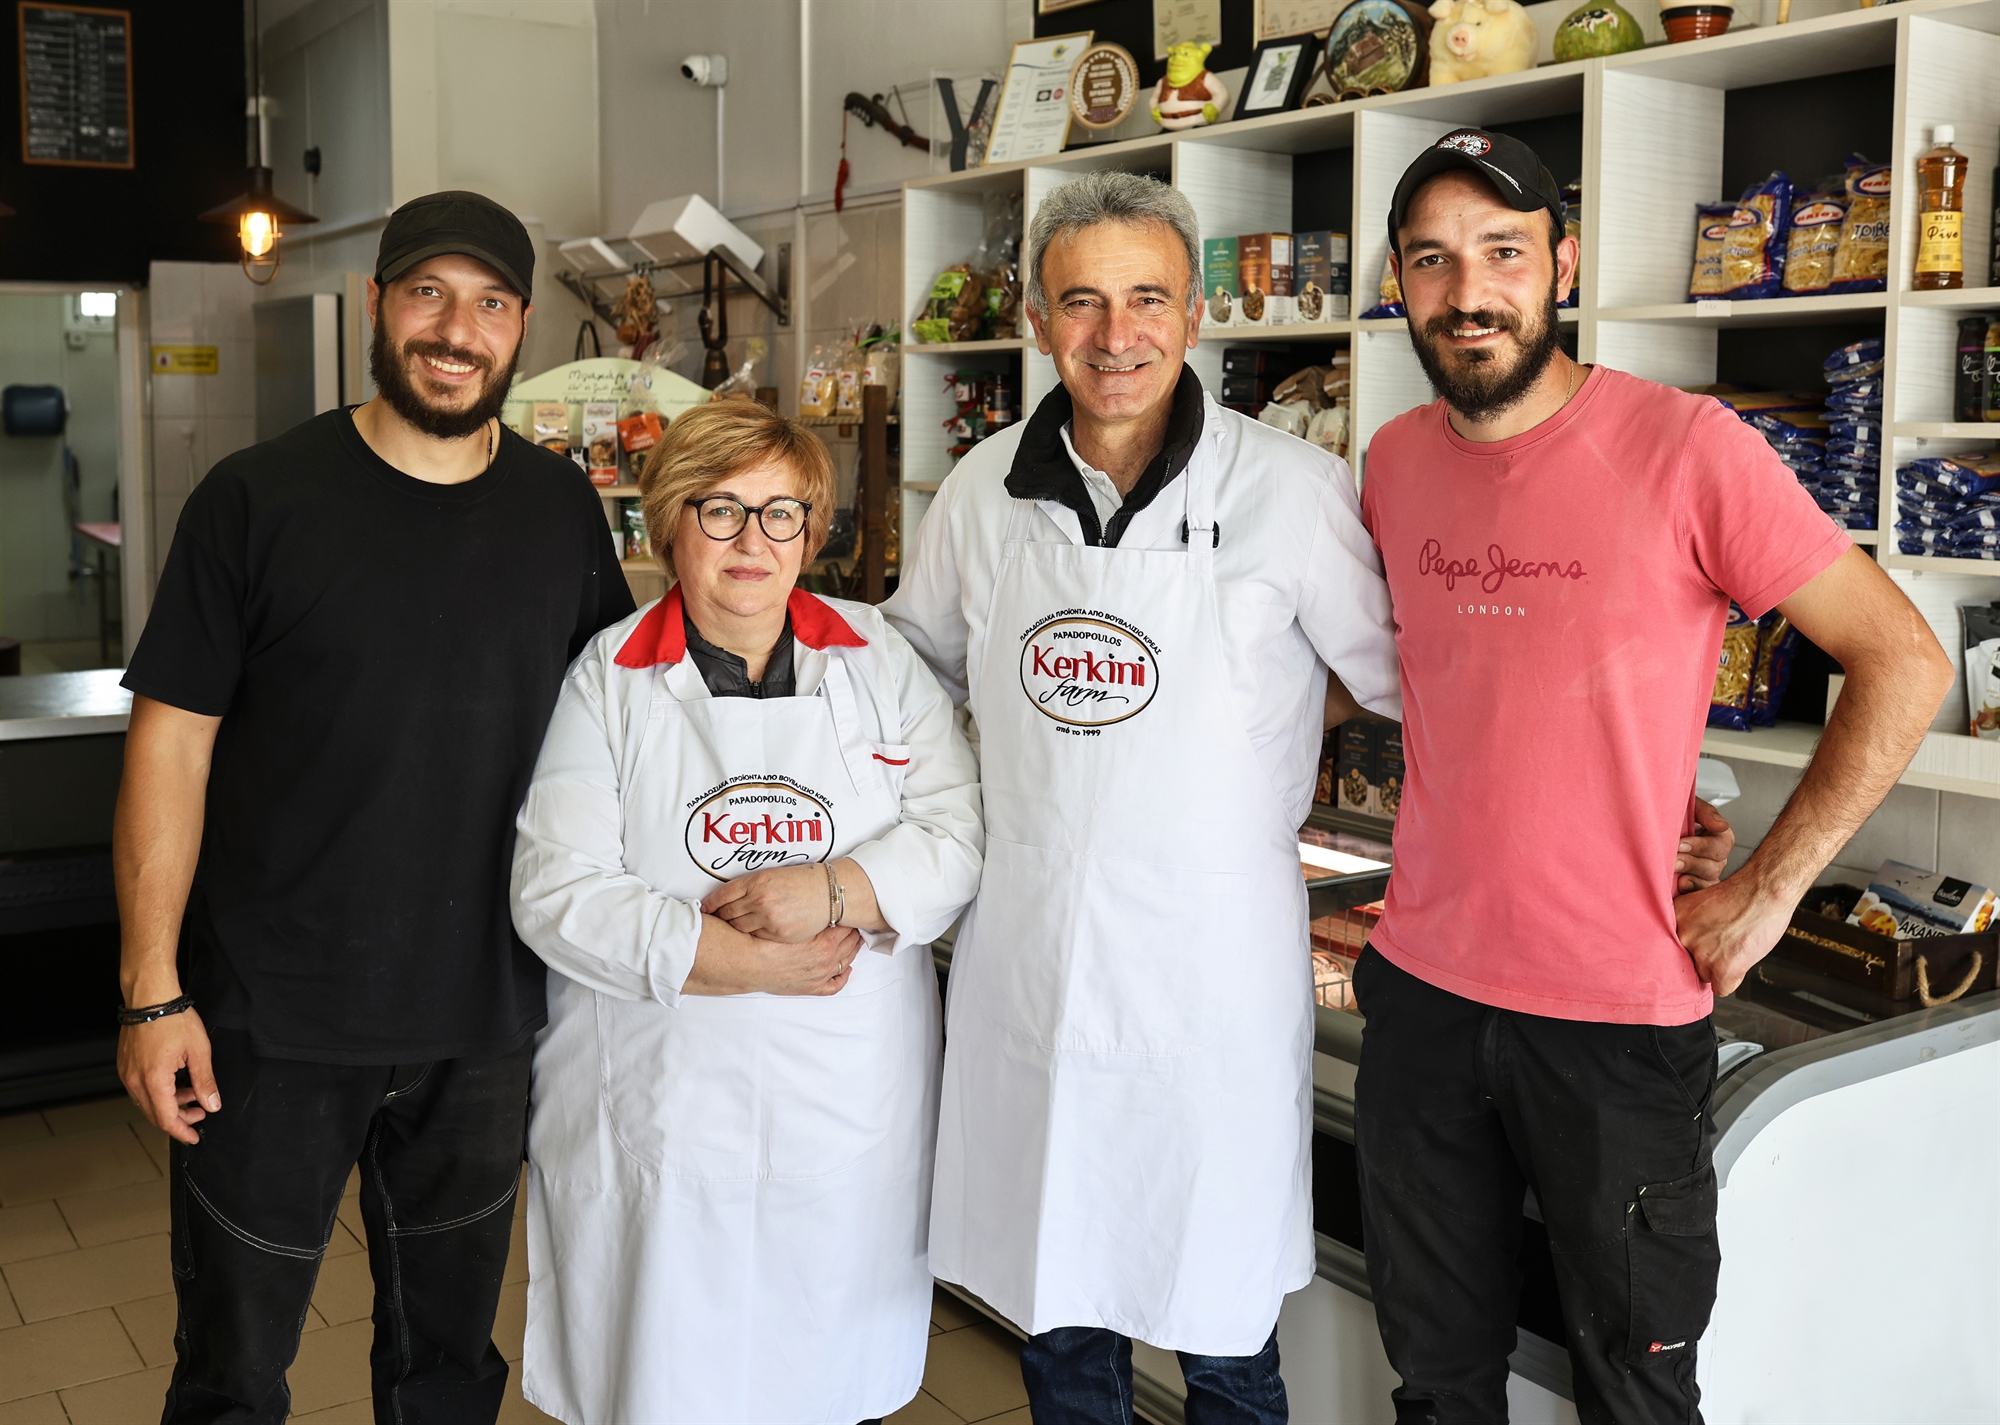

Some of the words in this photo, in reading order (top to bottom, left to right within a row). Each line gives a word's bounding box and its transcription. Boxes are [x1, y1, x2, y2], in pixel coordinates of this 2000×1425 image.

[1418, 538, 1482, 592] Pepe
[1481, 543, 1588, 594] Jeans
[1457, 604, 1526, 617] LONDON
[1053, 631, 1123, 647] PAPADOPOULOS
[1088, 609, 1104, 618] ΑΠΟ
[1143, 635, 1163, 656] ΚΡΕΑΣ
[1031, 644, 1146, 687] Kerkini
[1038, 678, 1130, 707] farm
[1055, 725, 1070, 734] από
[1082, 729, 1101, 737] 1999
[728, 795, 798, 806] PAPADOPOULOS
[814, 792, 835, 809] ΚΡΕΑΣ
[701, 811, 823, 845] Kerkini
[710, 842, 810, 871] farm
